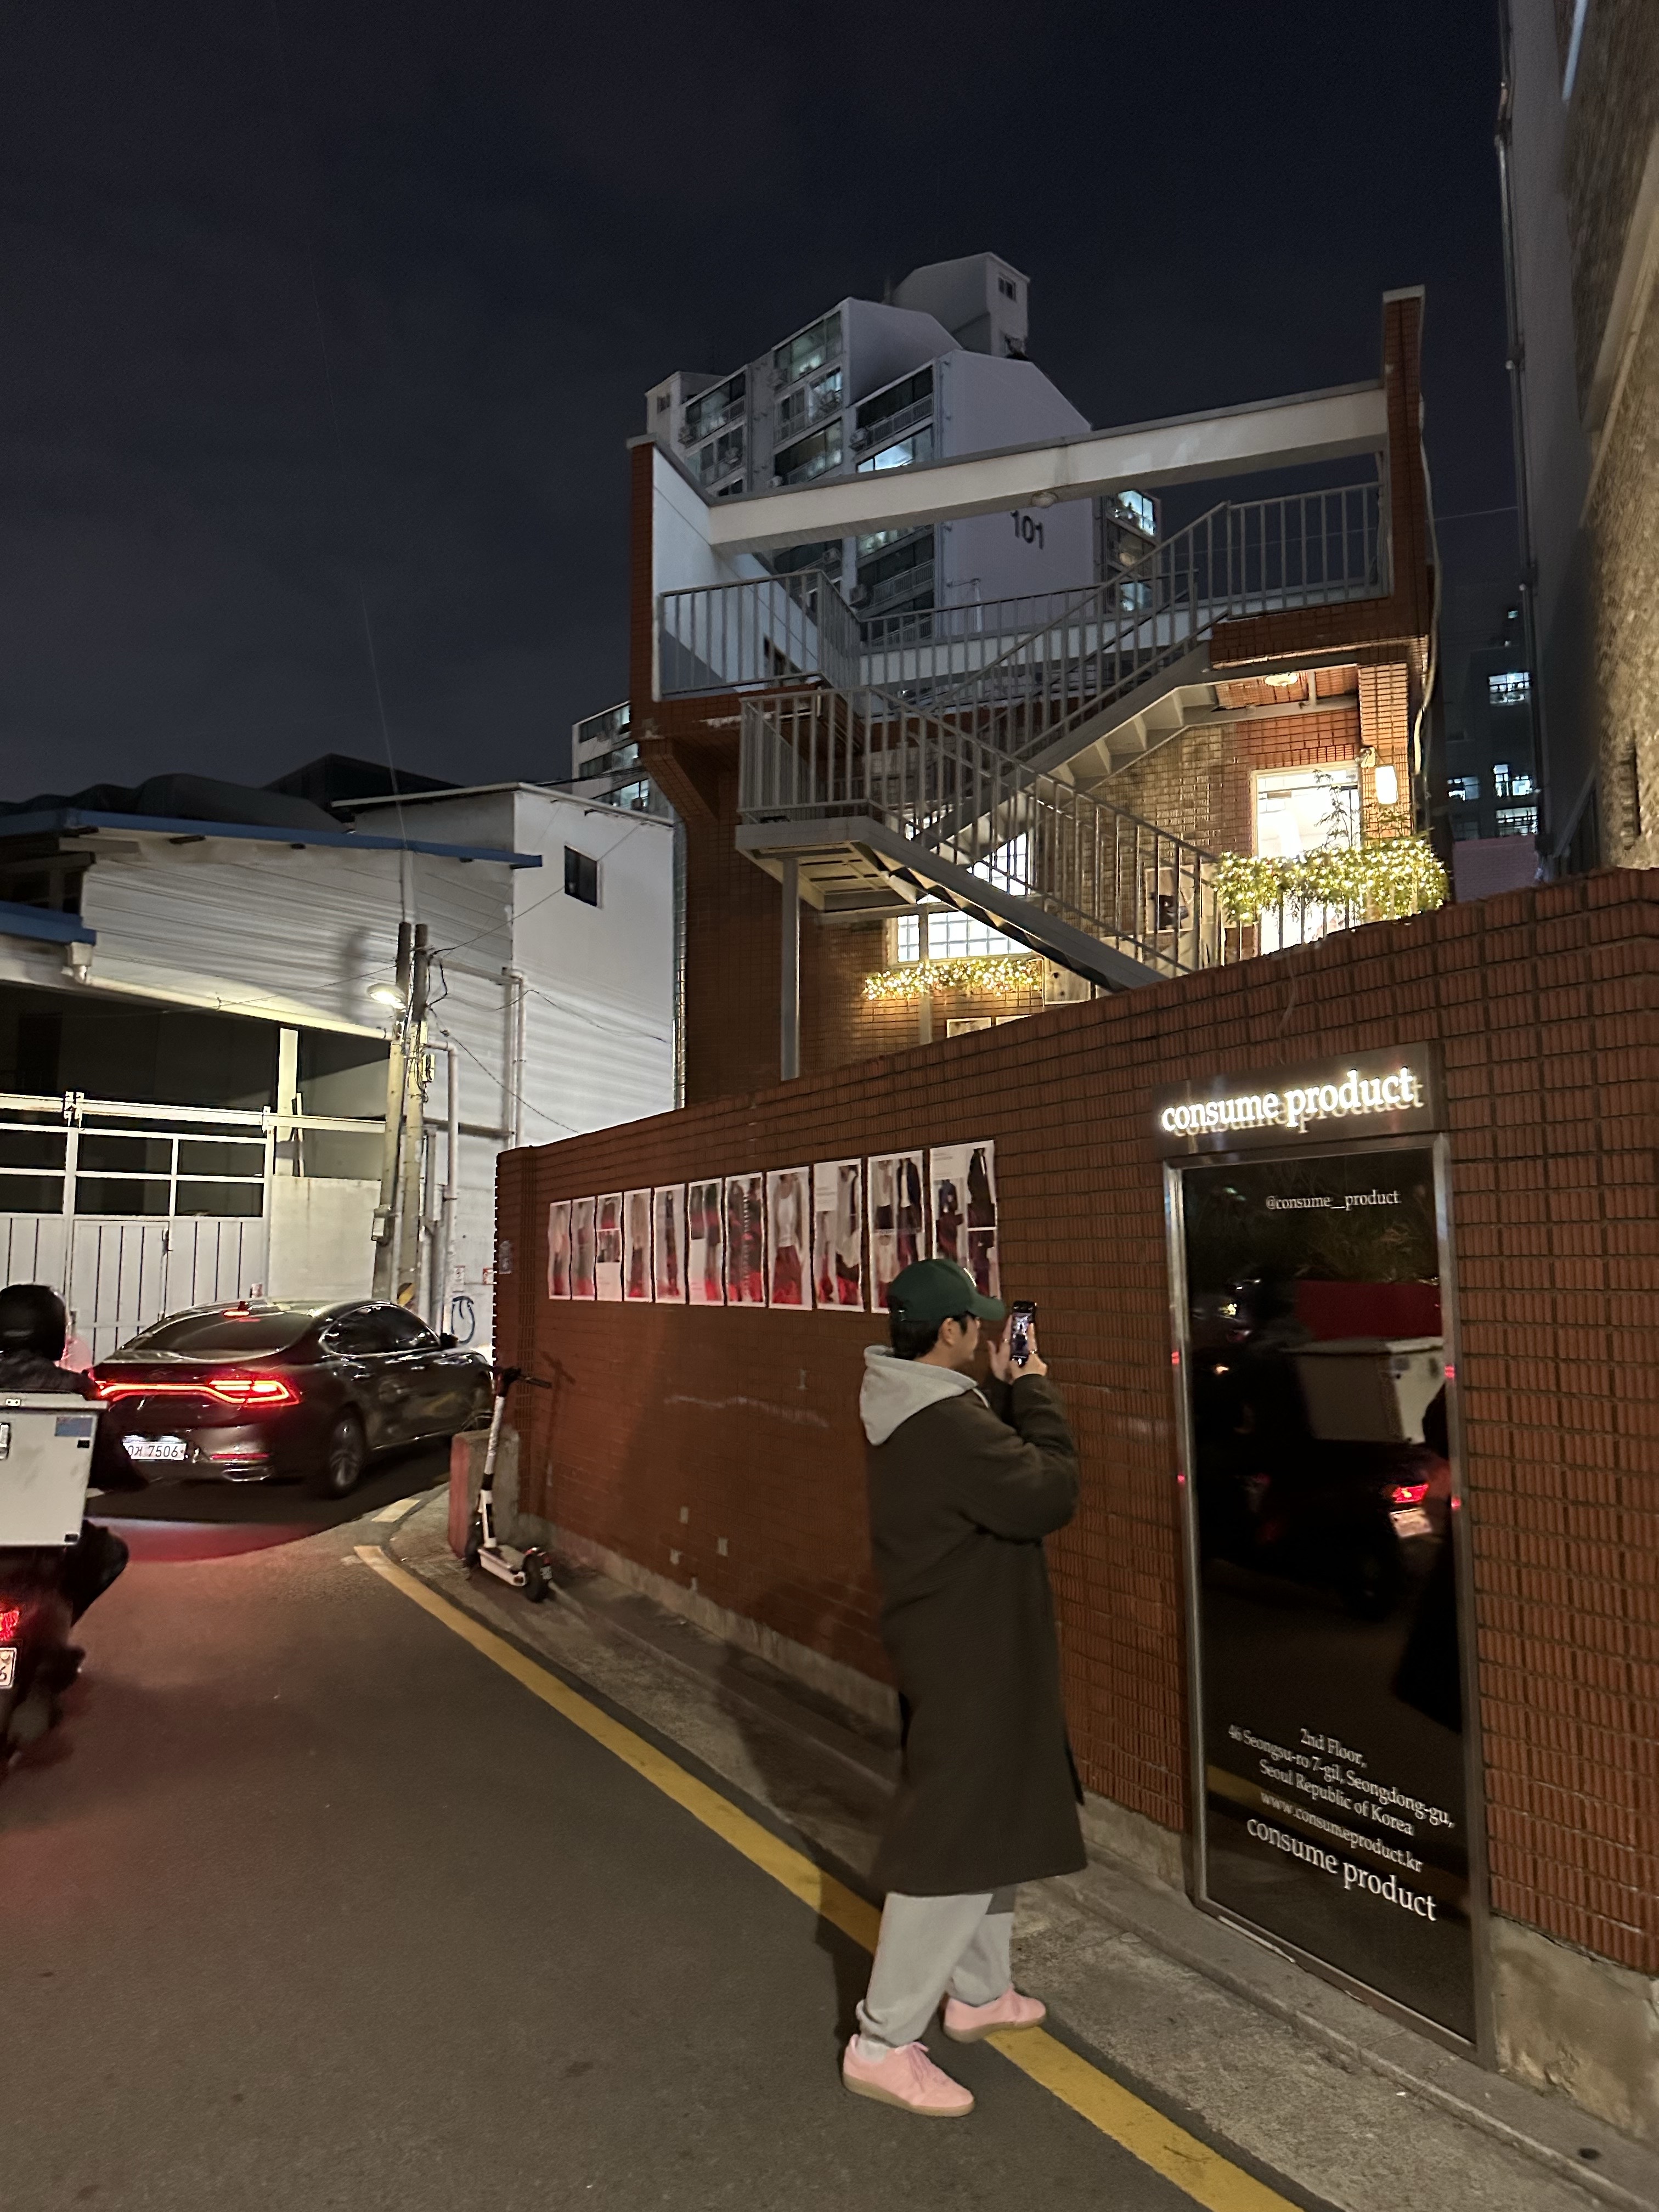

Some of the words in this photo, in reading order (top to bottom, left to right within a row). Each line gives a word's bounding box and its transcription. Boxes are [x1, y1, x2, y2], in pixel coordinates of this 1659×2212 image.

[1010, 510, 1045, 550] 101
[1161, 1091, 1279, 1132] consume
[1284, 1066, 1414, 1129] product
[148, 1445, 179, 1457] 7506
[1243, 1730, 1310, 1768] Seongsu-ro
[1312, 1756, 1345, 1784] 7-gil,
[1346, 1770, 1455, 1828] Seongdong-gu,
[1300, 1728, 1325, 1751] 2nd
[1327, 1737, 1367, 1768] Floor,
[1259, 1759, 1294, 1786] Seoul
[1296, 1773, 1352, 1810] Republic
[1354, 1801, 1370, 1817] of
[1371, 1803, 1415, 1836] Korea
[1261, 1792, 1423, 1873] www.consumeproduct.kr
[1247, 1819, 1339, 1875] consume
[1342, 1862, 1437, 1922] product
